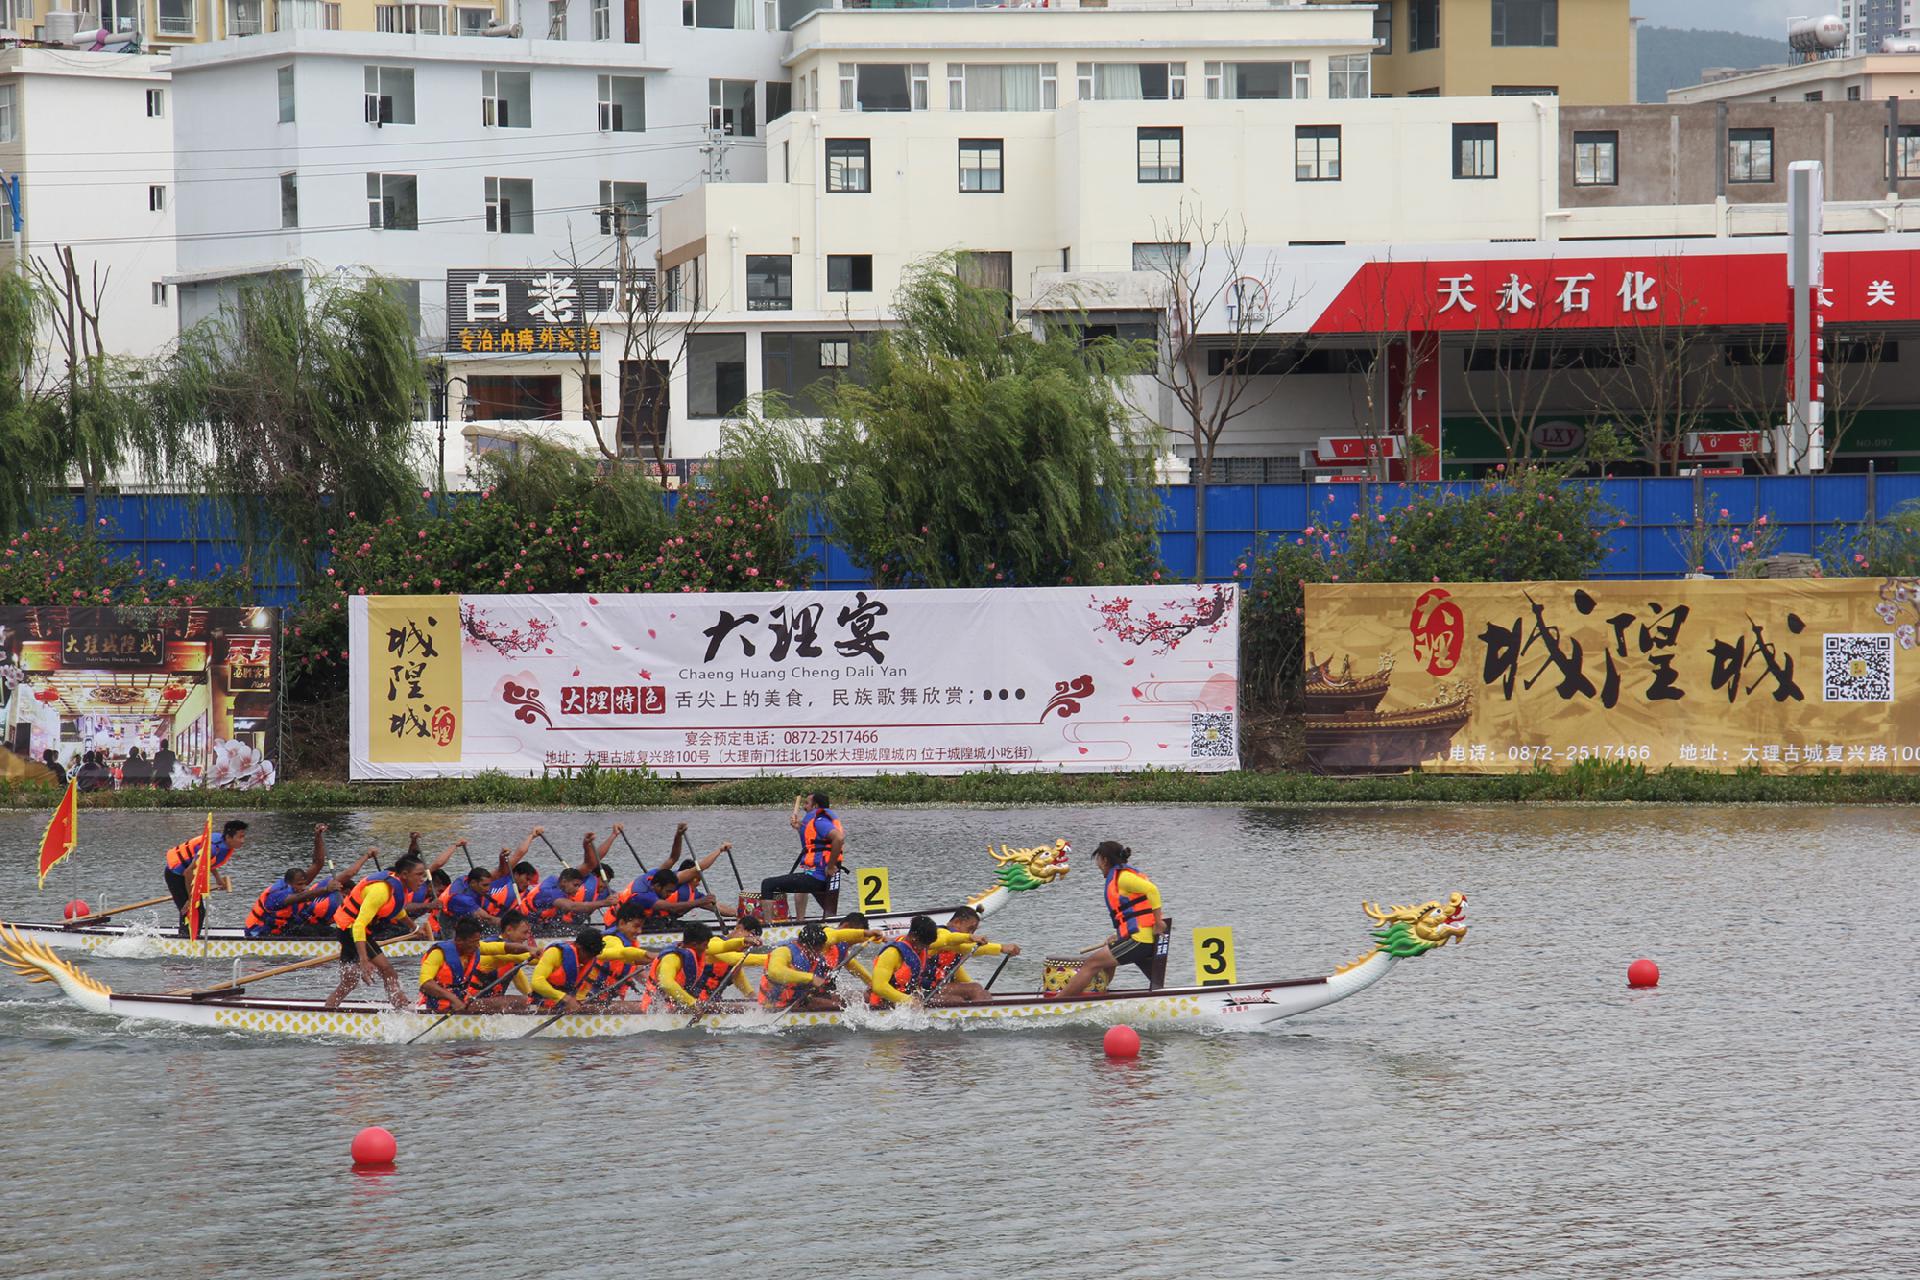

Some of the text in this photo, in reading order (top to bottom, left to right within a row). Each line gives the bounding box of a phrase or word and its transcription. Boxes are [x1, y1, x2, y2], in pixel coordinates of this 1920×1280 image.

[1437, 271, 1658, 314] 天永石化
[702, 591, 889, 664] 大理宴
[1477, 588, 1805, 709] 城隍城
[386, 615, 438, 739] 城隍城
[678, 665, 907, 682] Chaeng Huang Cheng Dali Yan
[561, 686, 665, 714] 大理特色
[863, 875, 884, 906] 2
[1201, 937, 1227, 975] 3
